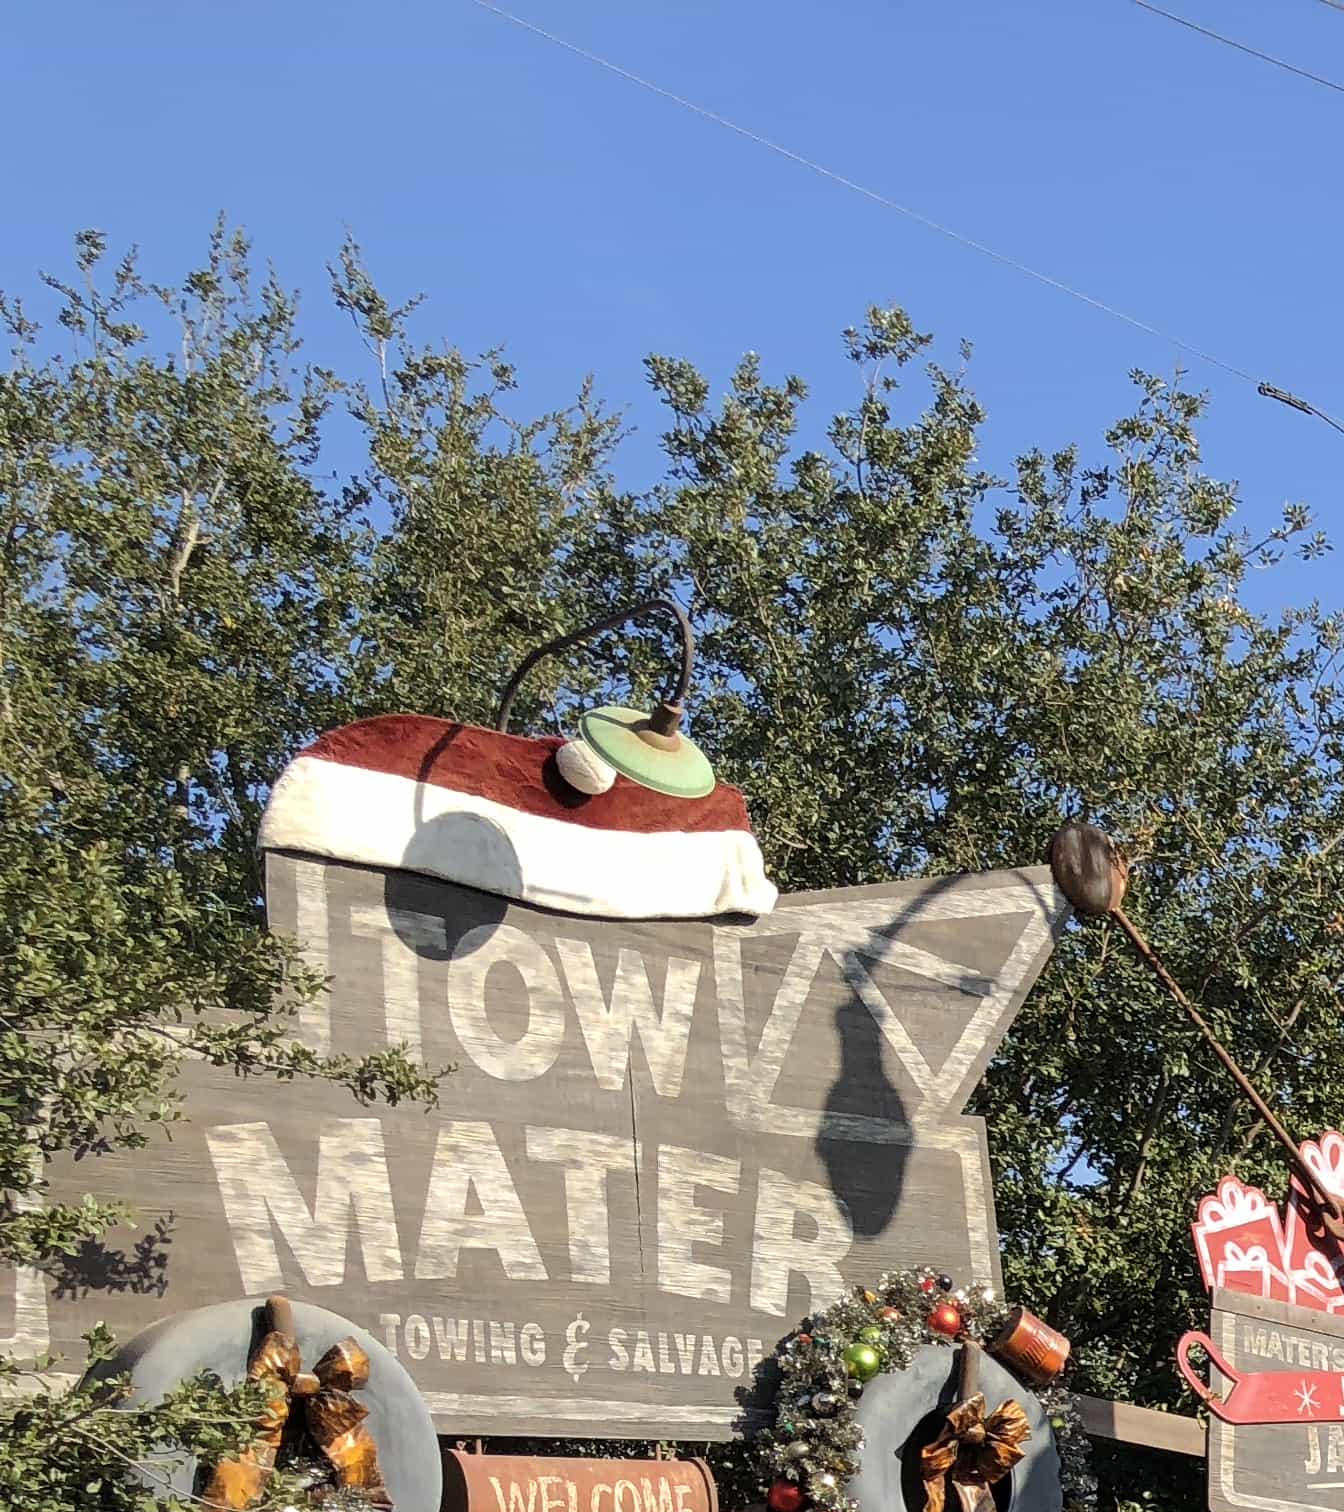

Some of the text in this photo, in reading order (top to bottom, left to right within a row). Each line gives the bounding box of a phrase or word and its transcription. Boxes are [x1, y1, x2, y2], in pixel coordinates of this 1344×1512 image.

[351, 906, 702, 1098] TOW
[205, 1117, 856, 1318] MATER
[380, 1312, 763, 1384] TOWING & SALVAGE
